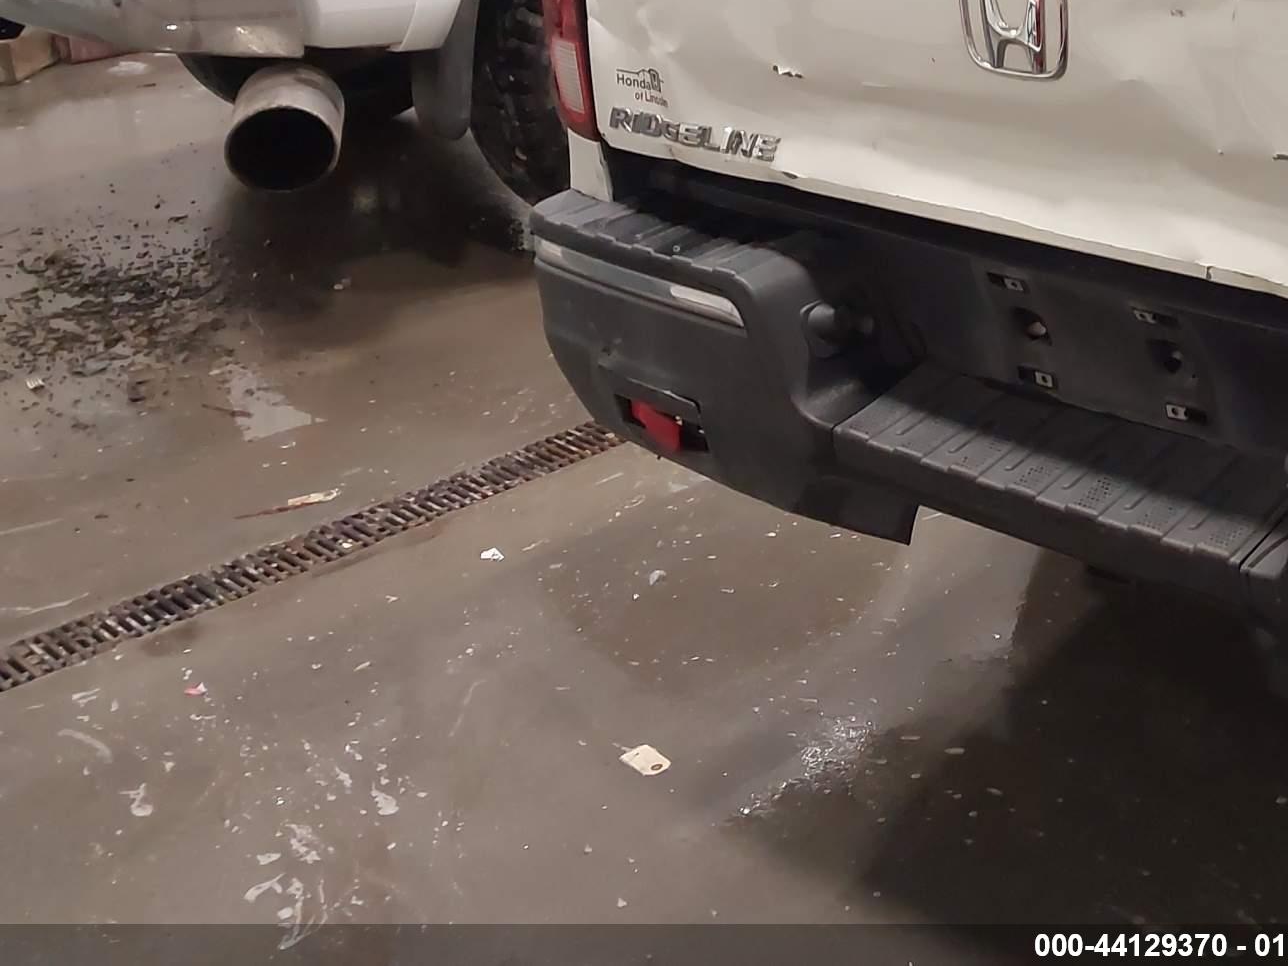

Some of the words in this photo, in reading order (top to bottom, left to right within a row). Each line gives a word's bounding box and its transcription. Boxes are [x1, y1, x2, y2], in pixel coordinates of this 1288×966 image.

[616, 72, 652, 91] Honda
[634, 90, 645, 101] of
[609, 106, 782, 163] RIDGELINE
